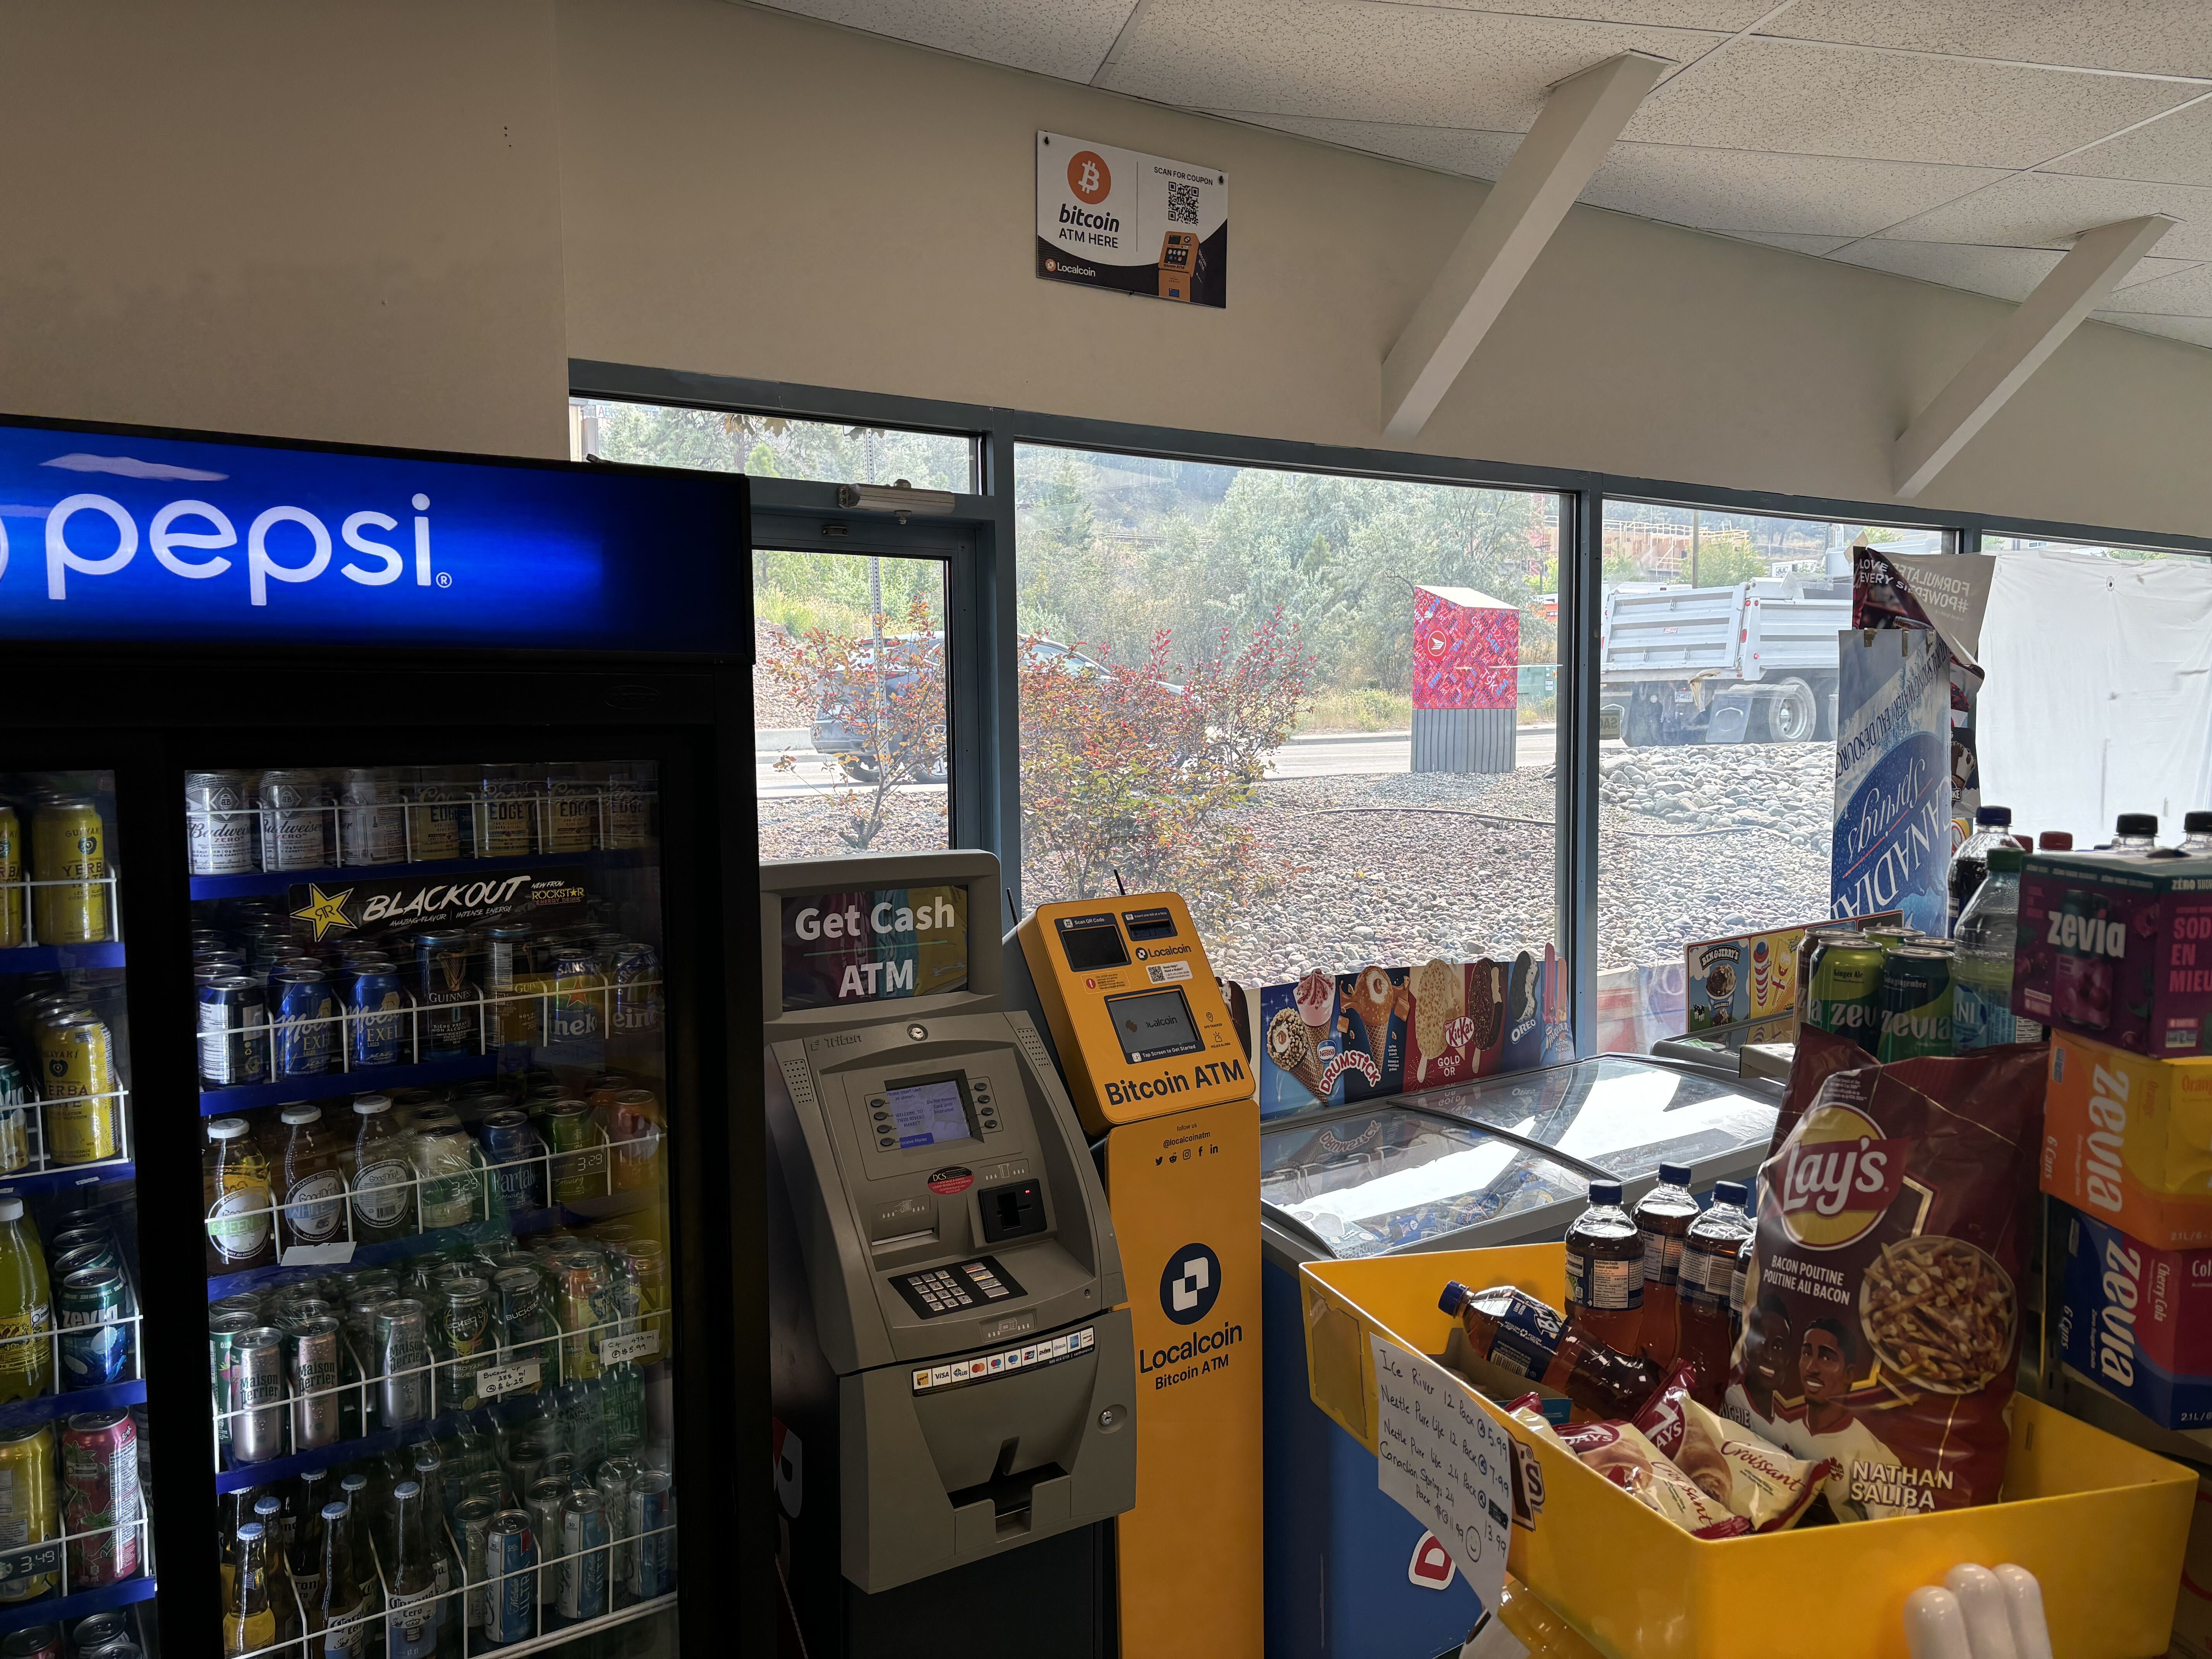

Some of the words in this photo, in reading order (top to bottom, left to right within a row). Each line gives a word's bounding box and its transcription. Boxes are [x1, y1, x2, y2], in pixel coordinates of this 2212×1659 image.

[1154, 167, 1171, 177] SCAN
[1173, 171, 1185, 180] FOR
[1187, 173, 1213, 185] COUPON
[1059, 203, 1120, 233] bitcoin
[1059, 228, 1085, 242] ATM
[1089, 233, 1118, 248] HERE
[1057, 262, 1096, 277] Localcoin
[46, 493, 431, 606] pepsi
[1860, 558, 1889, 572] LOVE
[1860, 572, 1894, 585] EVERY
[1894, 682, 1915, 722] WATER
[1865, 721, 1876, 750] DE
[1875, 709, 1892, 742] EAU
[1848, 758, 1926, 864] Springs
[362, 875, 531, 922] BLACKOUT
[531, 881, 546, 889] NEW
[421, 913, 446, 924] FLAVOR
[455, 908, 484, 919] INTENSE
[486, 904, 512, 916] ENERGY
[795, 905, 861, 941] Get
[871, 896, 955, 934] Cash
[2173, 916, 2212, 940] SOD
[2047, 908, 2126, 959] zevia
[1149, 943, 1192, 958] Localcoin
[2170, 943, 2197, 966] EN
[838, 959, 913, 998] ATM
[1833, 969, 1853, 978] Ginger
[2169, 969, 2212, 992] MIEU
[1449, 1020, 1474, 1046] KitKat
[1511, 1019, 1536, 1042] OREO
[1549, 1022, 1568, 1048] PARLOUR
[1881, 1008, 1951, 1039] zevia
[1319, 1049, 1382, 1096] DRUMSTICK
[1437, 1055, 1460, 1066] GOLD
[1443, 1067, 1456, 1077] OR
[1104, 1070, 1190, 1106] Bitcoin
[1194, 1059, 1245, 1089] ATM
[1163, 1131, 1211, 1149] @localcoinatm
[2086, 1063, 2130, 1213] zevia
[577, 1154, 603, 1172] 3.29
[933, 1172, 946, 1182] DCS
[1783, 1137, 1888, 1216] Lay's
[2044, 1147, 2057, 1180] Cans
[212, 1220, 254, 1235] GREEN
[1771, 1255, 1799, 1274] BACON
[1799, 1262, 1844, 1286] POUTINE
[2152, 1262, 2171, 1295] Cherry
[1763, 1269, 1796, 1290] POUTINE
[1797, 1279, 1811, 1294] AU
[1813, 1283, 1850, 1305] BACON
[2100, 1238, 2141, 1387] zevia
[2154, 1297, 2168, 1322] Cola
[1140, 1321, 1242, 1374] Localcoin
[2061, 1317, 2073, 1350] Cans
[239, 1374, 279, 1389] Maison
[298, 1361, 335, 1378] Maison
[934, 1372, 949, 1380] VISA
[1155, 1365, 1198, 1390] Bitcoin
[1202, 1354, 1229, 1375] ATM
[1379, 1349, 1403, 1377] Ice
[1412, 1367, 1435, 1395] River
[1444, 1390, 1455, 1409] 12
[1459, 1400, 1474, 1428] Pack
[1415, 1400, 1429, 1428] Pure
[1449, 1430, 1458, 1446] 12
[1463, 1439, 1478, 1467] Pack
[1489, 1465, 1509, 1498] 7.99
[1380, 1441, 1418, 1479] Canadian
[1446, 1487, 1455, 1508] 24
[1411, 1437, 1425, 1459] Pure
[1448, 1464, 1459, 1484] 24
[1464, 1473, 1477, 1499] Pack
[1720, 1439, 1806, 1492] Croissant
[1852, 1460, 1954, 1491] NATHAN
[1850, 1482, 1936, 1510] SALIBA
[21, 1550, 55, 1575] 3.49
[403, 1607, 422, 1618] Cero
